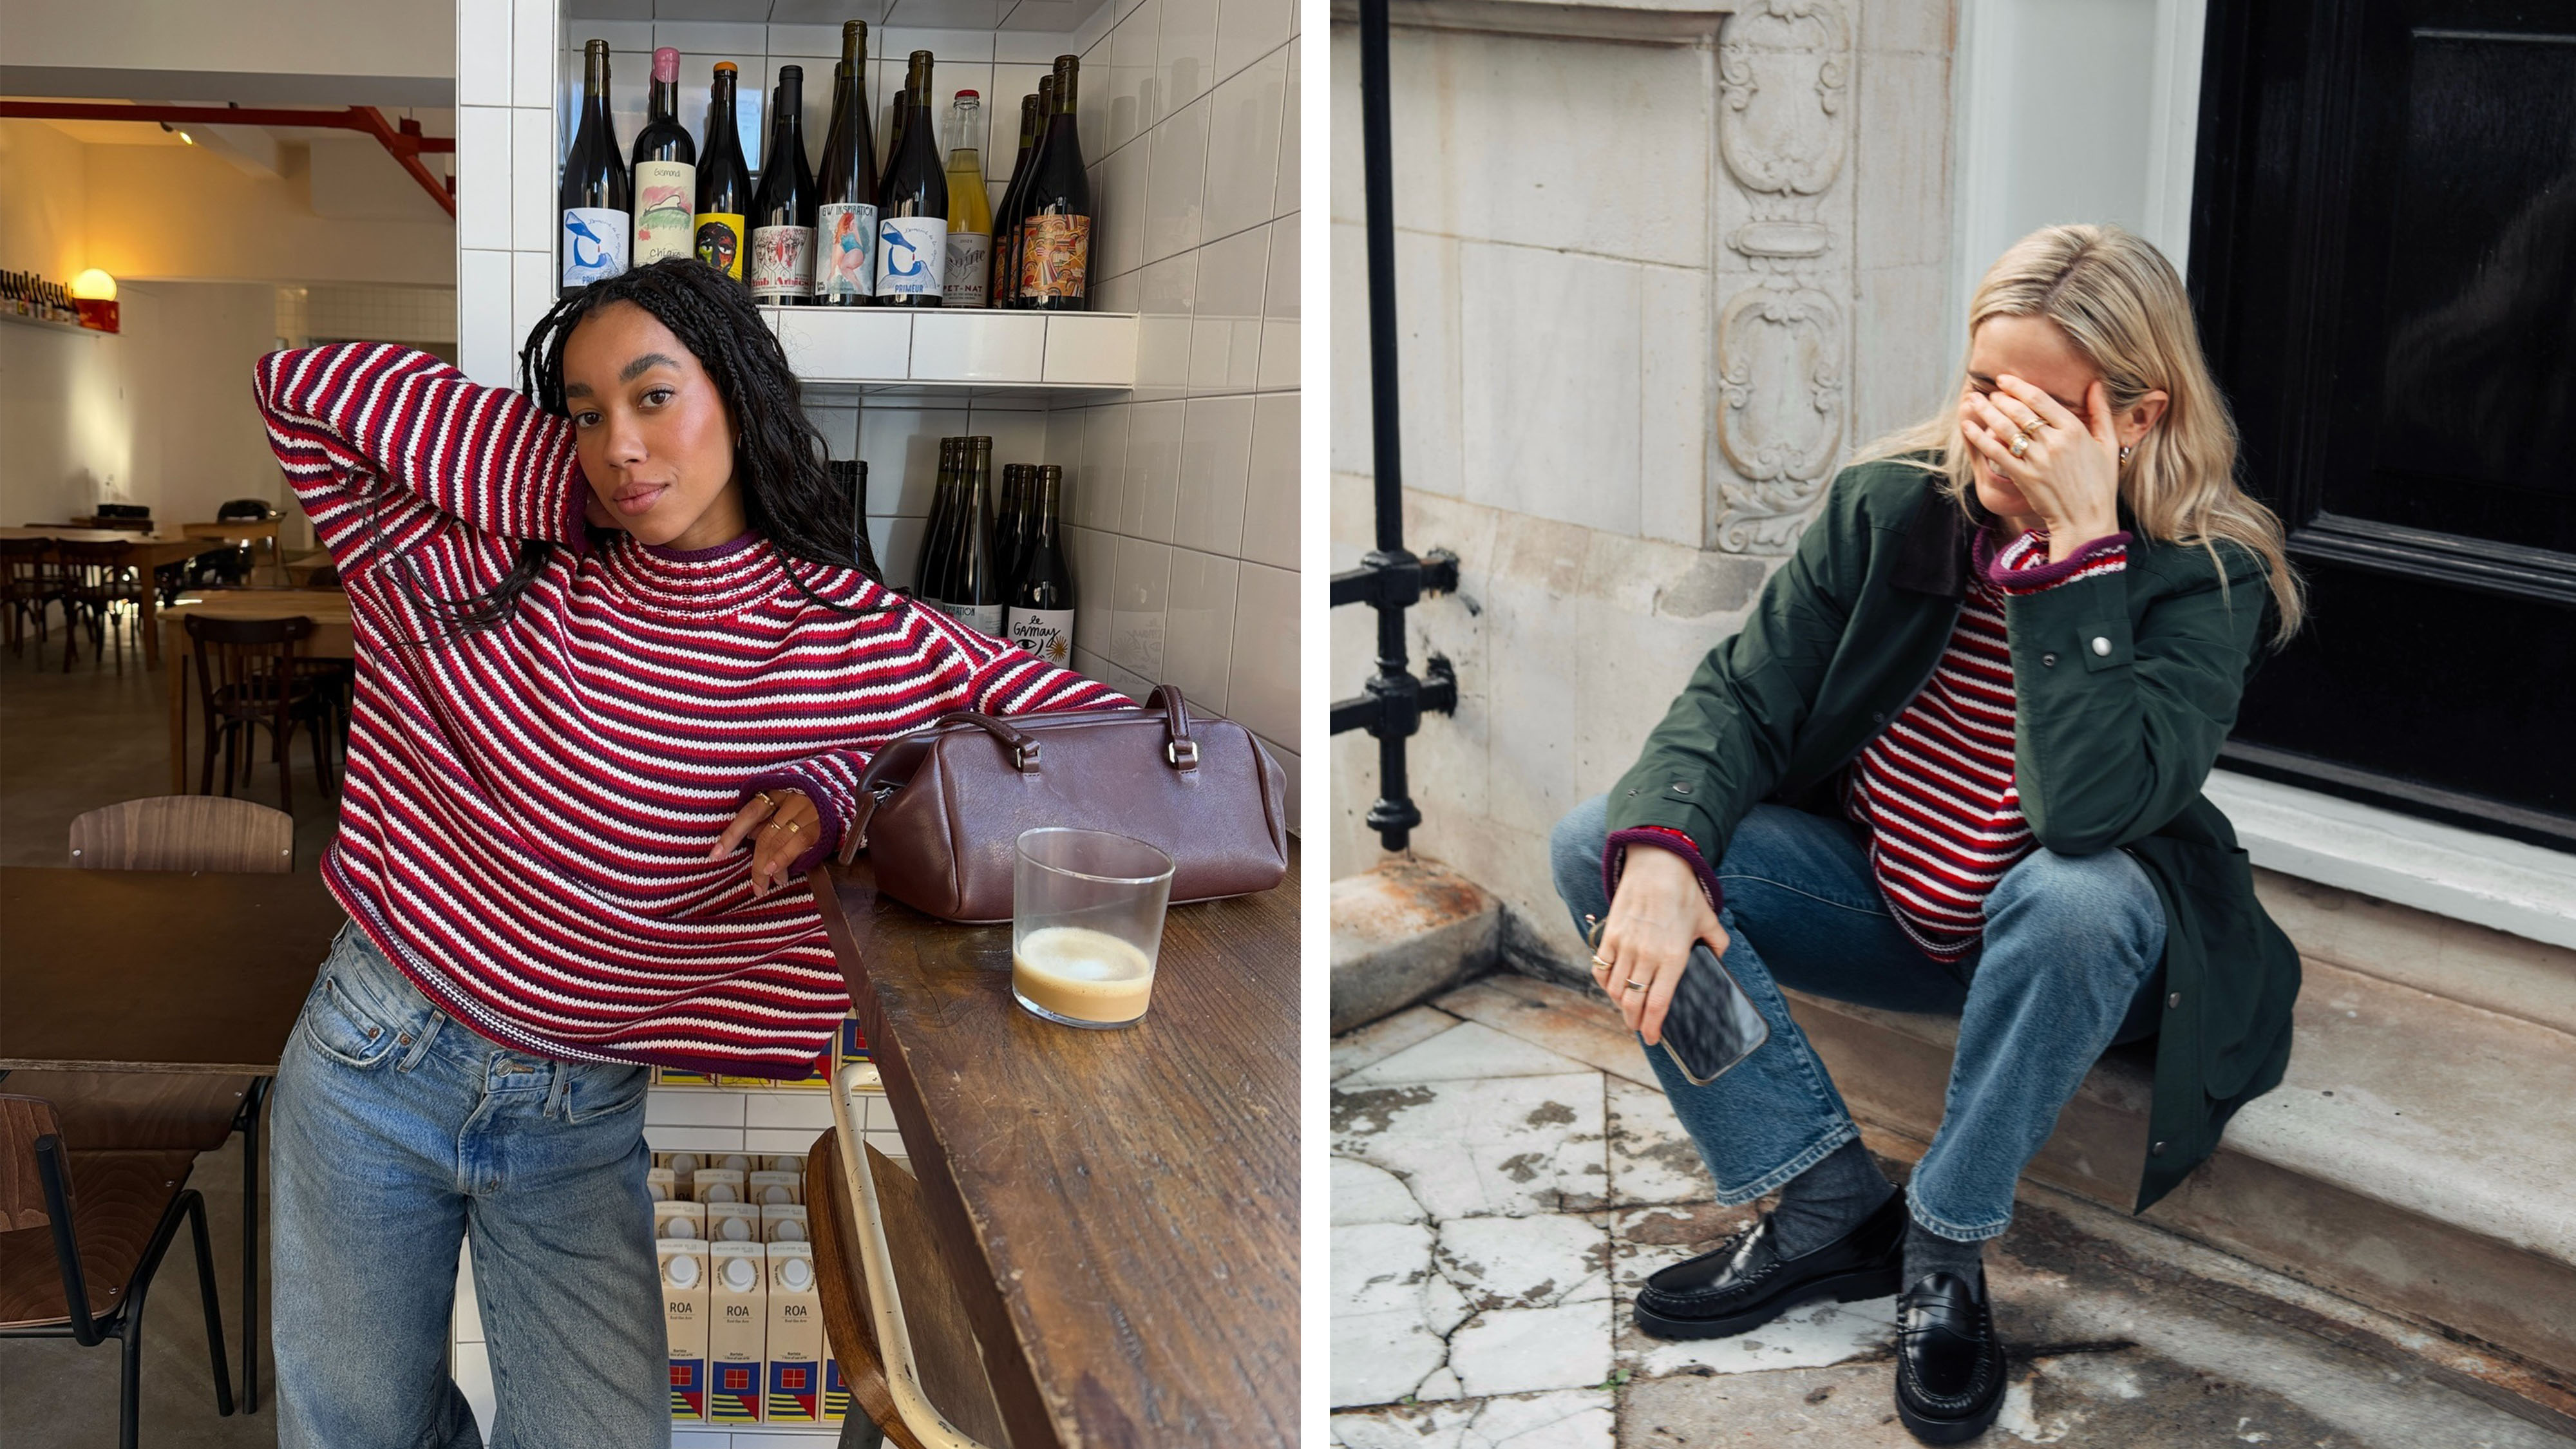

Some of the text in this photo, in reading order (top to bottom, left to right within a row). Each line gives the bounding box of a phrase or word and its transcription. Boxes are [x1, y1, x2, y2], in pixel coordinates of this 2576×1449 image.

[822, 205, 873, 216] GW INSPIRATION
[895, 284, 923, 293] PRIMEUR
[1028, 615, 1043, 625] le
[670, 1302, 692, 1313] ROA
[726, 1305, 749, 1316] ROA
[784, 1305, 807, 1316] ROA
